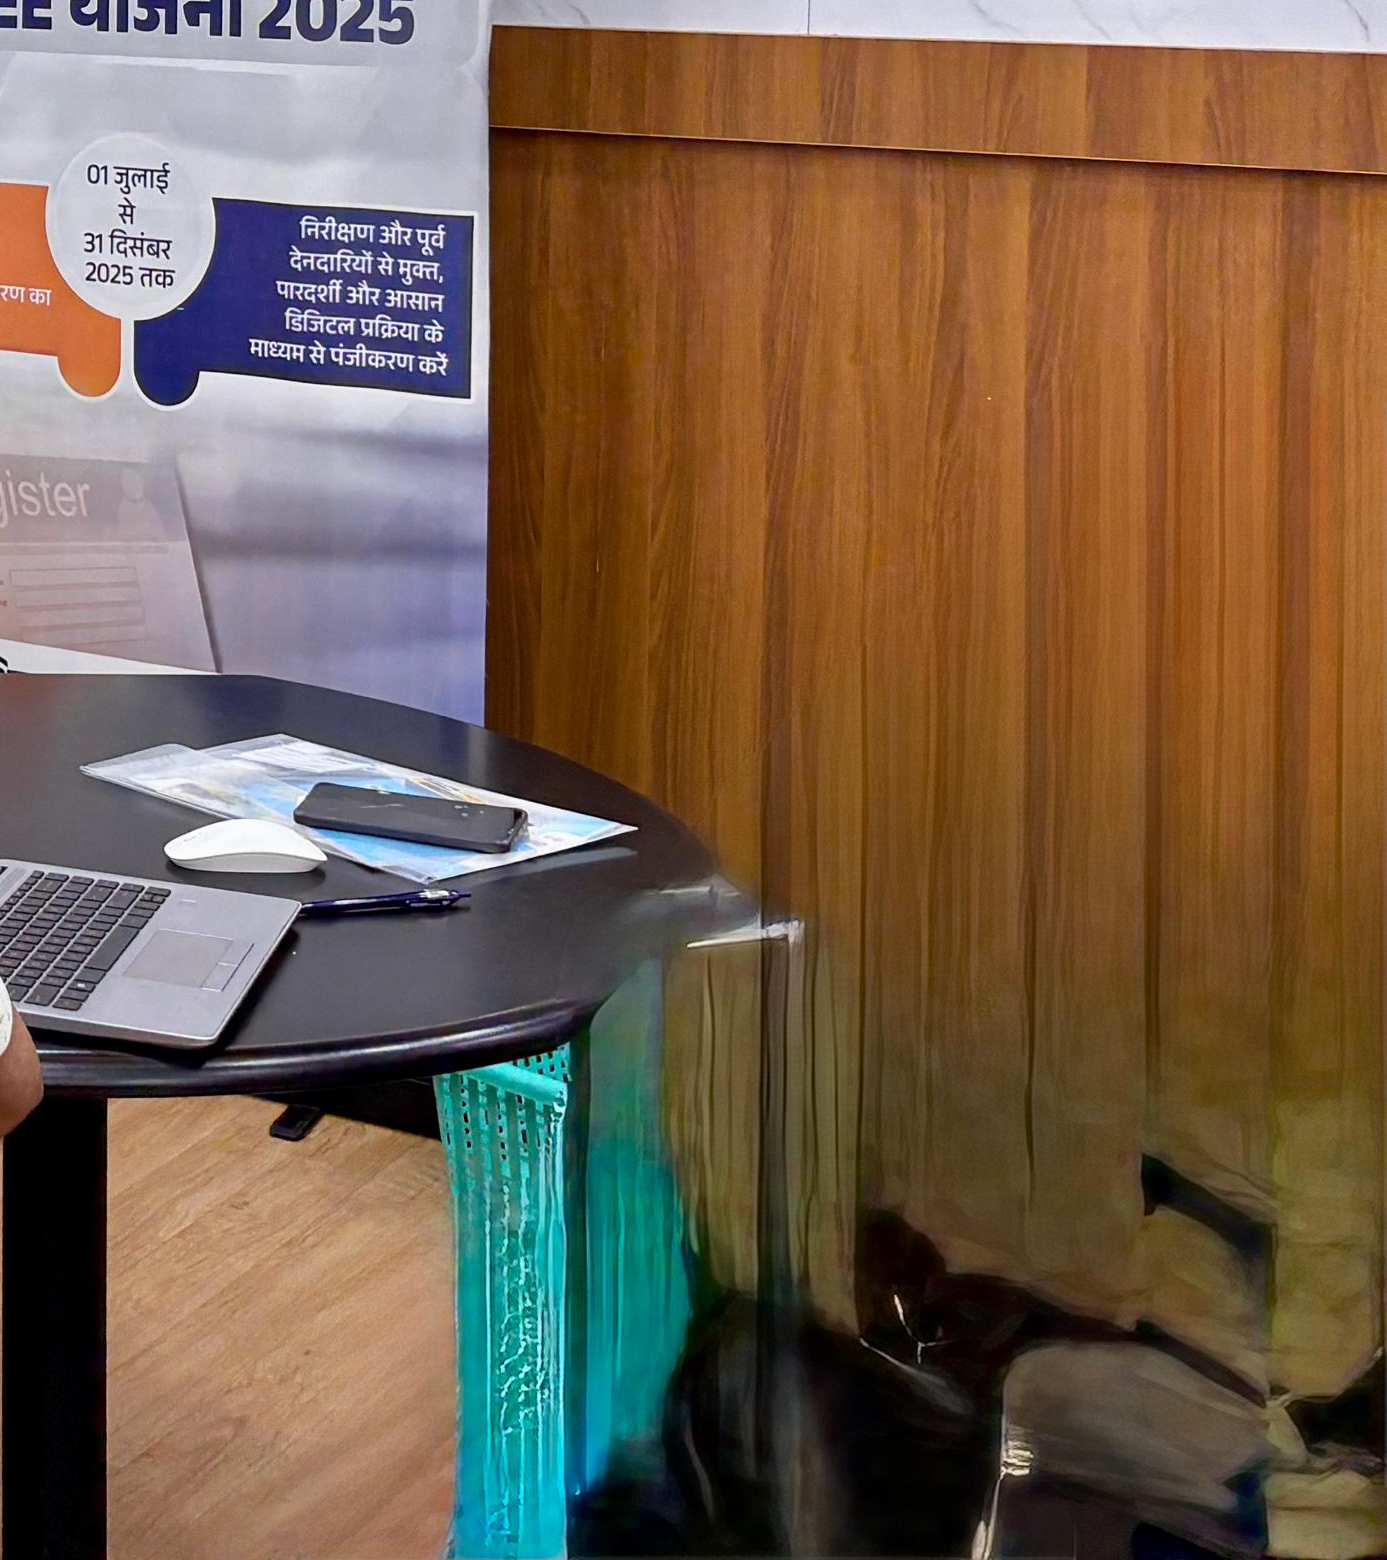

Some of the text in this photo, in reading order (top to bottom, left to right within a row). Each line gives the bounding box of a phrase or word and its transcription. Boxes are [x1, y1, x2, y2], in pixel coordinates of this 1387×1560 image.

[87, 162, 170, 194] 01 जुलाई
[118, 197, 136, 224] से
[84, 228, 172, 260] 31 दिसंबर
[299, 216, 446, 256] निरीक्षण और पूर्व
[85, 262, 176, 289] 2025 तक
[290, 245, 445, 285] देनदारियों से मुक्त,
[30, 283, 51, 305] का
[276, 279, 443, 312] पारदर्शी और आसान
[285, 307, 444, 344] डिजिटल प्रक्रिया के
[249, 338, 448, 376] माध्यम से पंजीकरण करें
